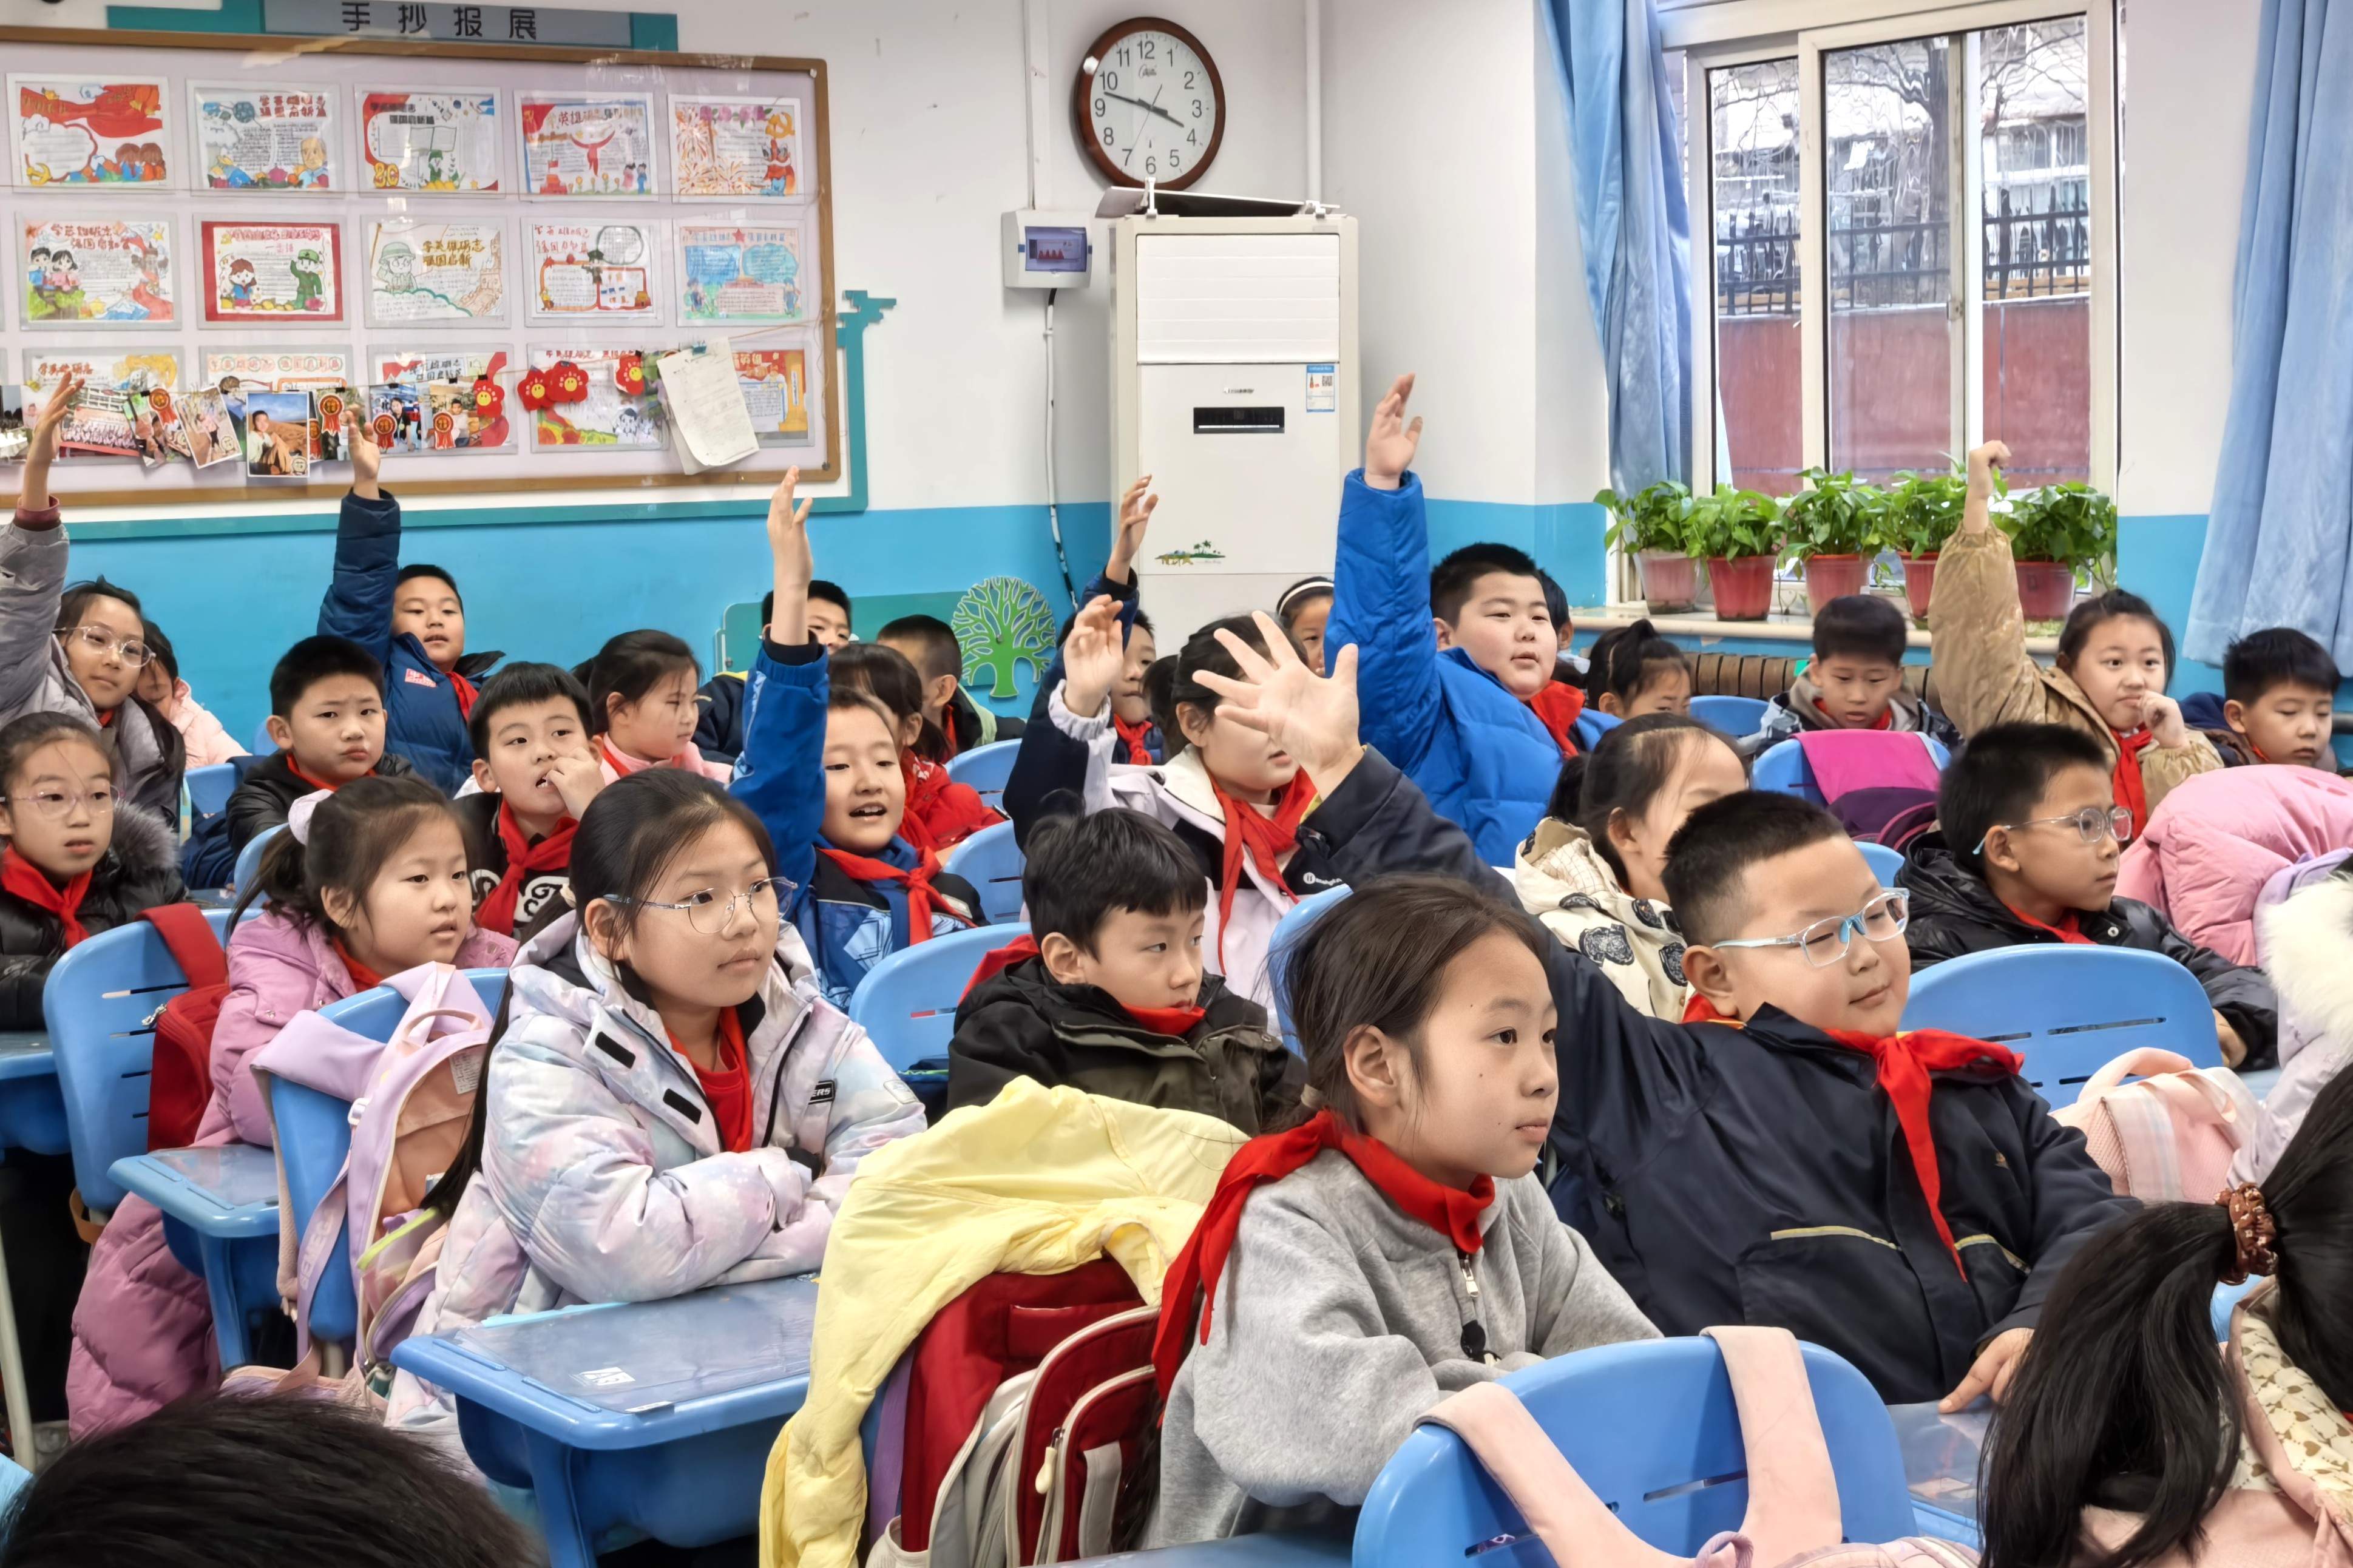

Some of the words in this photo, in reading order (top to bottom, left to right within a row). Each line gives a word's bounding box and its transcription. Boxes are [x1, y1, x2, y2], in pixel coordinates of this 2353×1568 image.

[341, 2, 537, 39] 手抄报展
[1117, 47, 1129, 67] 11
[1137, 40, 1155, 59] 12
[1166, 49, 1173, 67] 1
[1099, 71, 1118, 90] 10
[1184, 71, 1194, 90] 2
[1094, 98, 1106, 117] 9
[1192, 100, 1202, 118] 3
[1103, 127, 1114, 146] 8
[1187, 128, 1197, 146] 4
[1122, 149, 1132, 166] 7
[1145, 156, 1156, 175] 6
[1170, 149, 1180, 167] 5
